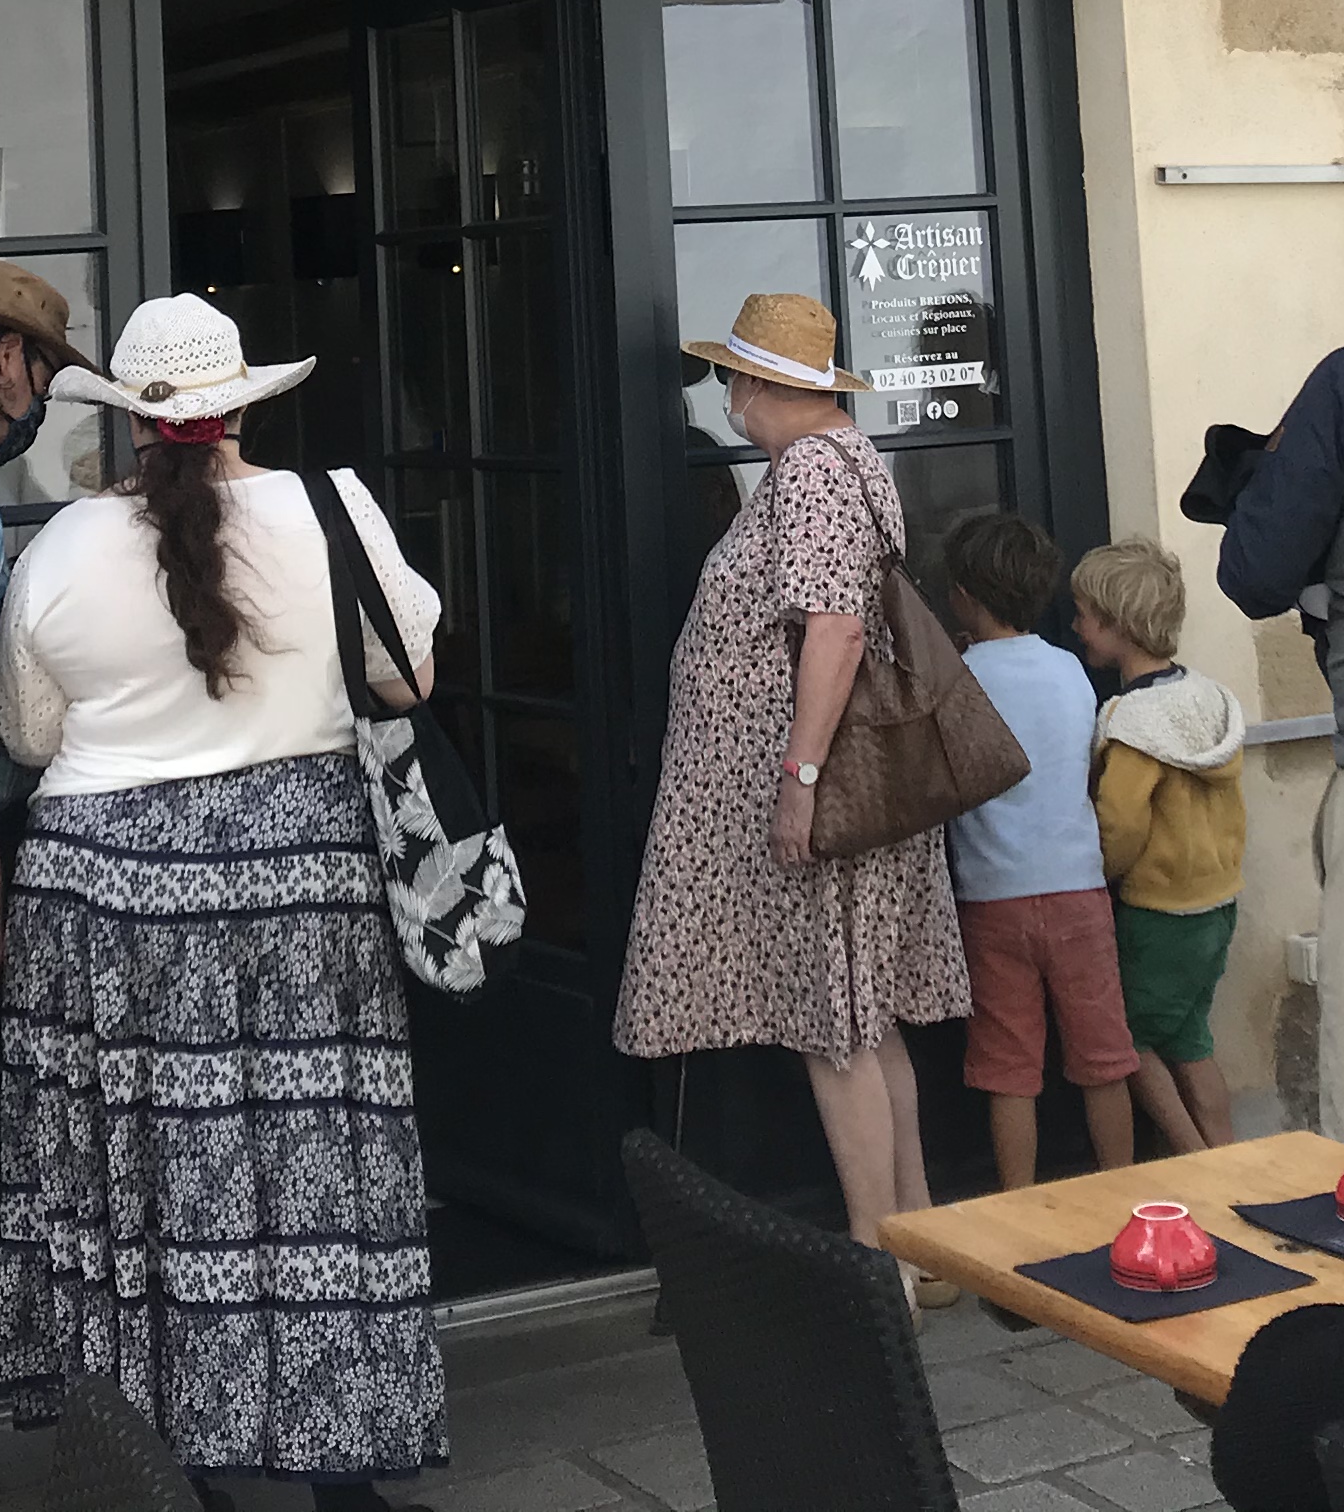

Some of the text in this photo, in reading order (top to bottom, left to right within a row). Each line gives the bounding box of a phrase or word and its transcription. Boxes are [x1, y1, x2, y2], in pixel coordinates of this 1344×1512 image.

[894, 222, 984, 251] Artisan
[896, 250, 981, 282] Crêpier
[872, 293, 973, 310] Produits BRETONS,
[872, 309, 976, 325] Locaux et Régionaux,
[881, 323, 967, 338] cuisinés sur place
[893, 352, 959, 364] Réservez au
[879, 366, 976, 388] 02 40 23 02 07
